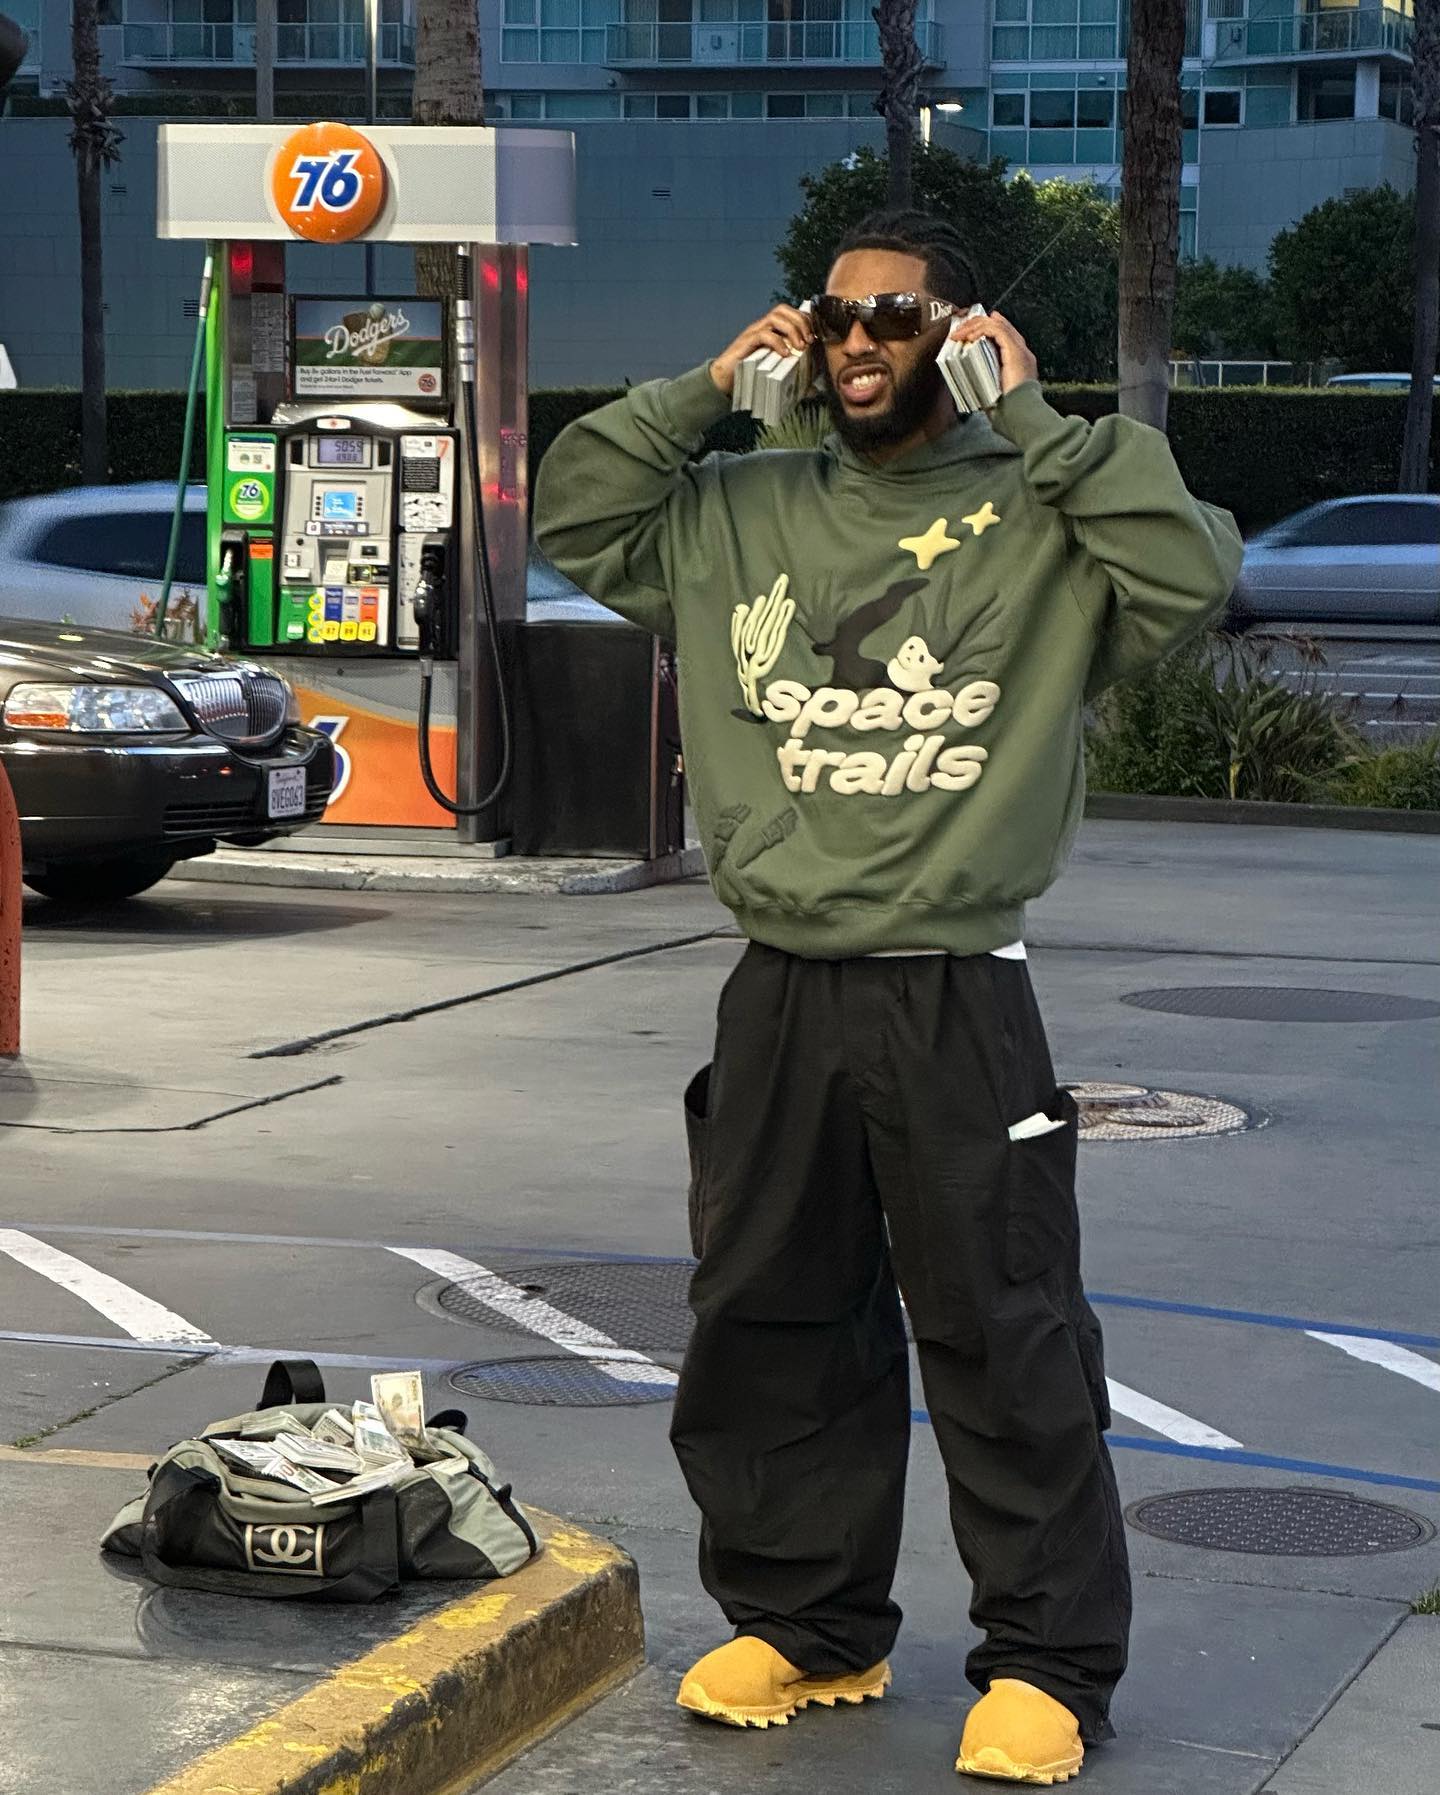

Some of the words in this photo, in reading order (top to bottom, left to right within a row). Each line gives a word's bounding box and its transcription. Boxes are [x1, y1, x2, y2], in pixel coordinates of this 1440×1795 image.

[289, 149, 363, 213] 76
[325, 308, 410, 359] Dodgers
[928, 301, 953, 321] Dior
[436, 438, 449, 459] 7
[239, 483, 260, 498] 76
[761, 679, 1001, 738] space
[776, 734, 988, 797] trails
